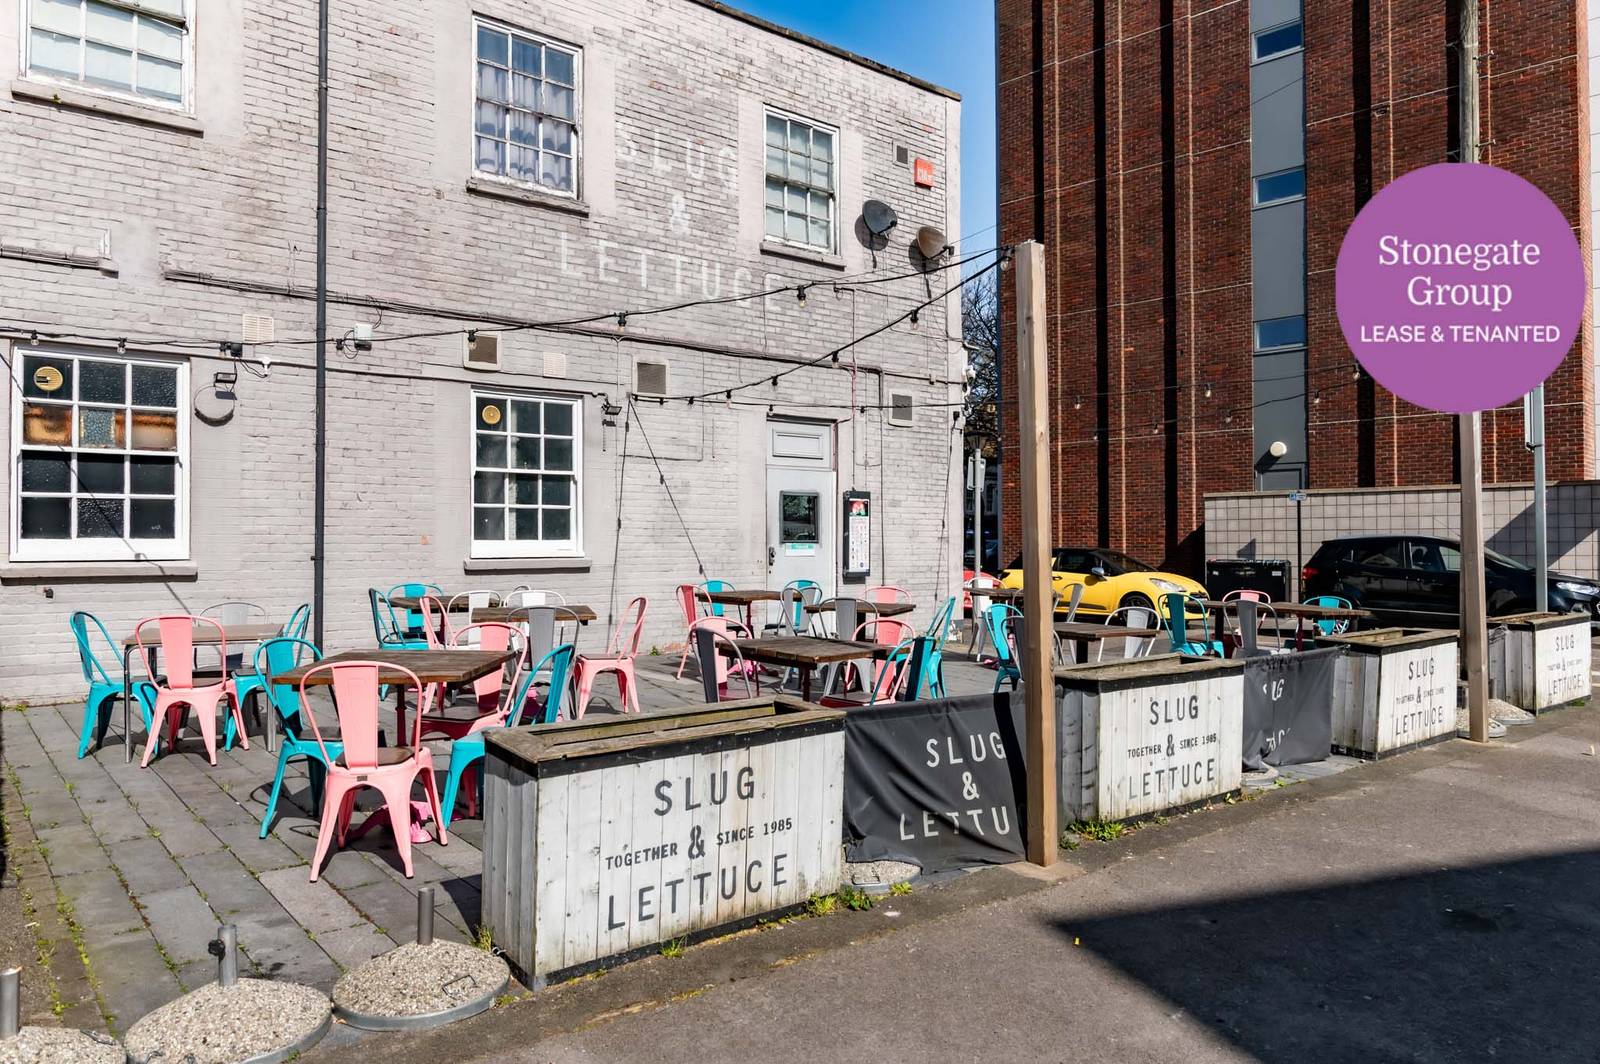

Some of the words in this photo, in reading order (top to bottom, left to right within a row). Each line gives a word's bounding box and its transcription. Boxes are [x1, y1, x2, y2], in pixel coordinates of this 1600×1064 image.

[614, 120, 738, 195] SLUG
[561, 231, 786, 312] LETTUCE
[1408, 657, 1434, 680] SLUG
[1149, 695, 1198, 725] SLUG
[1395, 706, 1442, 736] LETTUCE
[926, 732, 1006, 768] SLUG
[1128, 744, 1161, 759] TOGETHER
[1166, 734, 1175, 757] &
[1180, 737, 1198, 749] SINCE
[653, 766, 755, 817] SLUG
[962, 771, 980, 800] &
[1129, 758, 1215, 800] LETTUCE
[605, 842, 678, 870] TOGETHER
[687, 824, 706, 860] &
[716, 825, 755, 847] SINCE
[763, 817, 793, 837] 1985
[607, 853, 788, 931] LETTUCE
